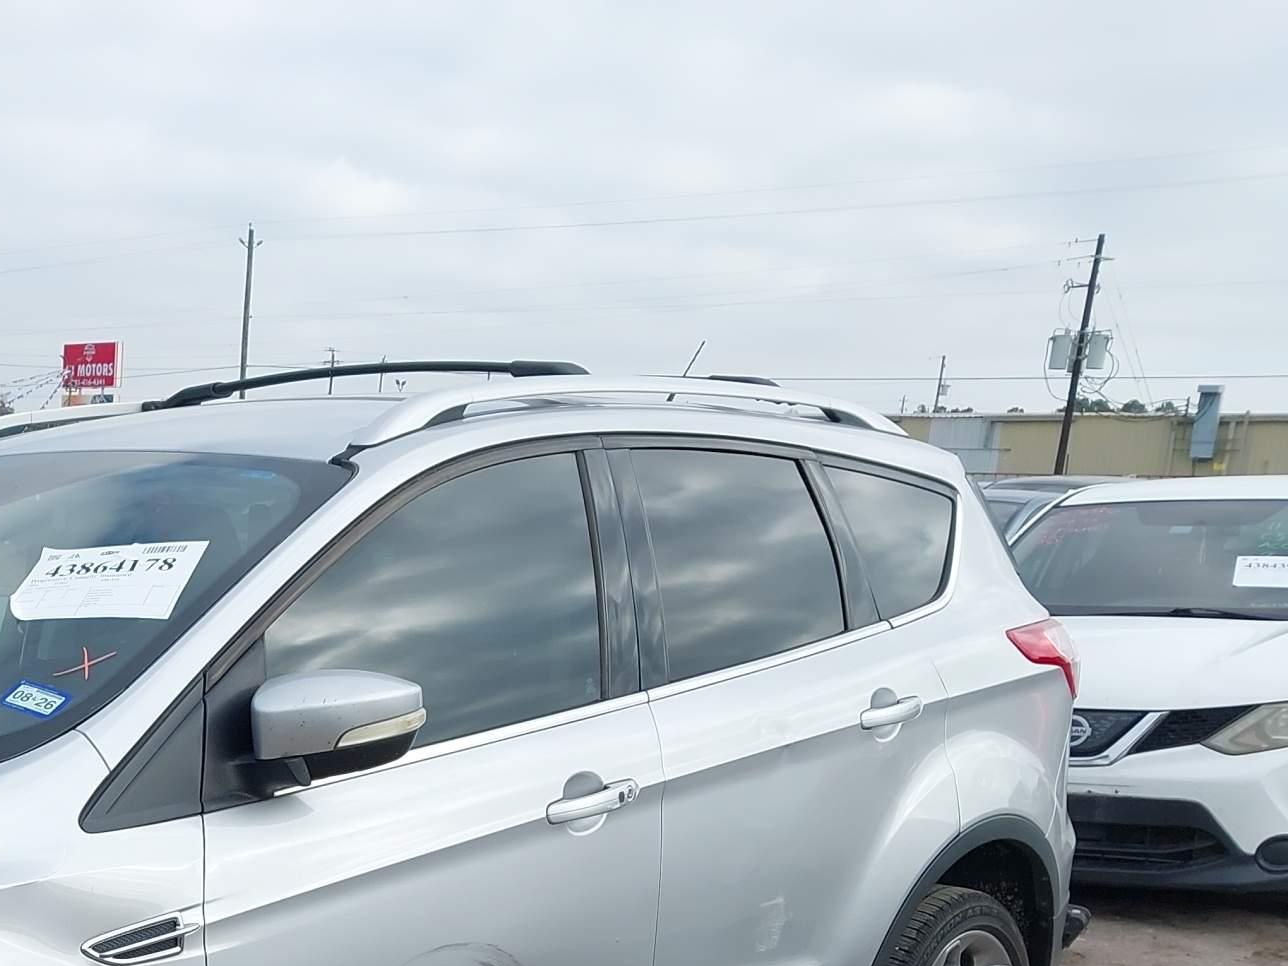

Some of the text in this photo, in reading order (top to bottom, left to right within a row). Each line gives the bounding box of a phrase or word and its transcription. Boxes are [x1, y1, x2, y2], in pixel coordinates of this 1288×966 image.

[77, 363, 113, 377] MOTORS
[45, 557, 177, 578] 43864178
[12, 690, 33, 702] 08
[33, 697, 57, 710] 26
